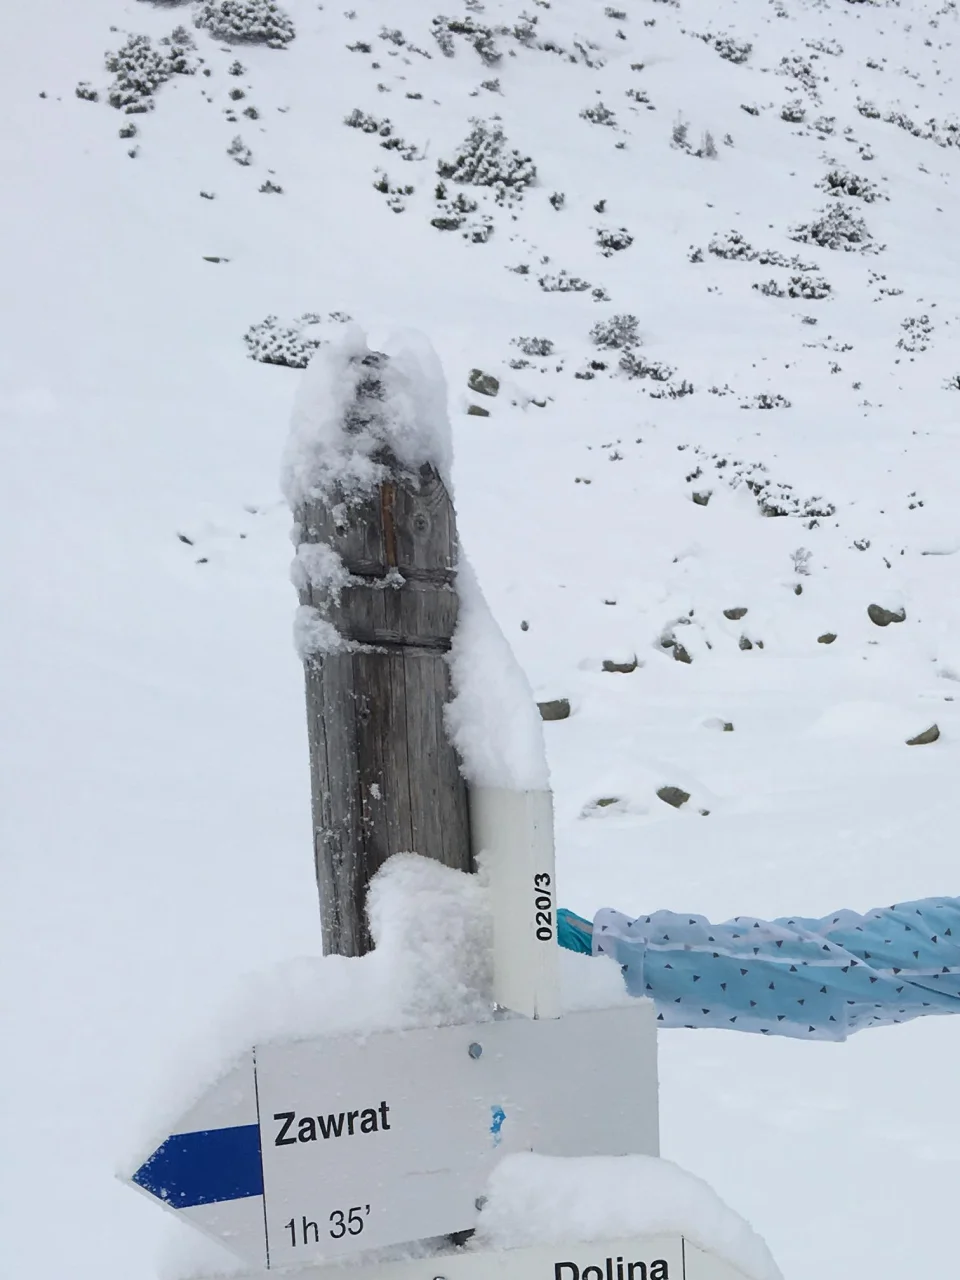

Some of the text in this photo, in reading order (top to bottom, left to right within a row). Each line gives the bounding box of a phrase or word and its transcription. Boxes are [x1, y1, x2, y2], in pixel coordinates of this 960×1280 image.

[534, 872, 553, 942] 020/3
[273, 1101, 391, 1147] Zawrat
[284, 1216, 320, 1247] 1h
